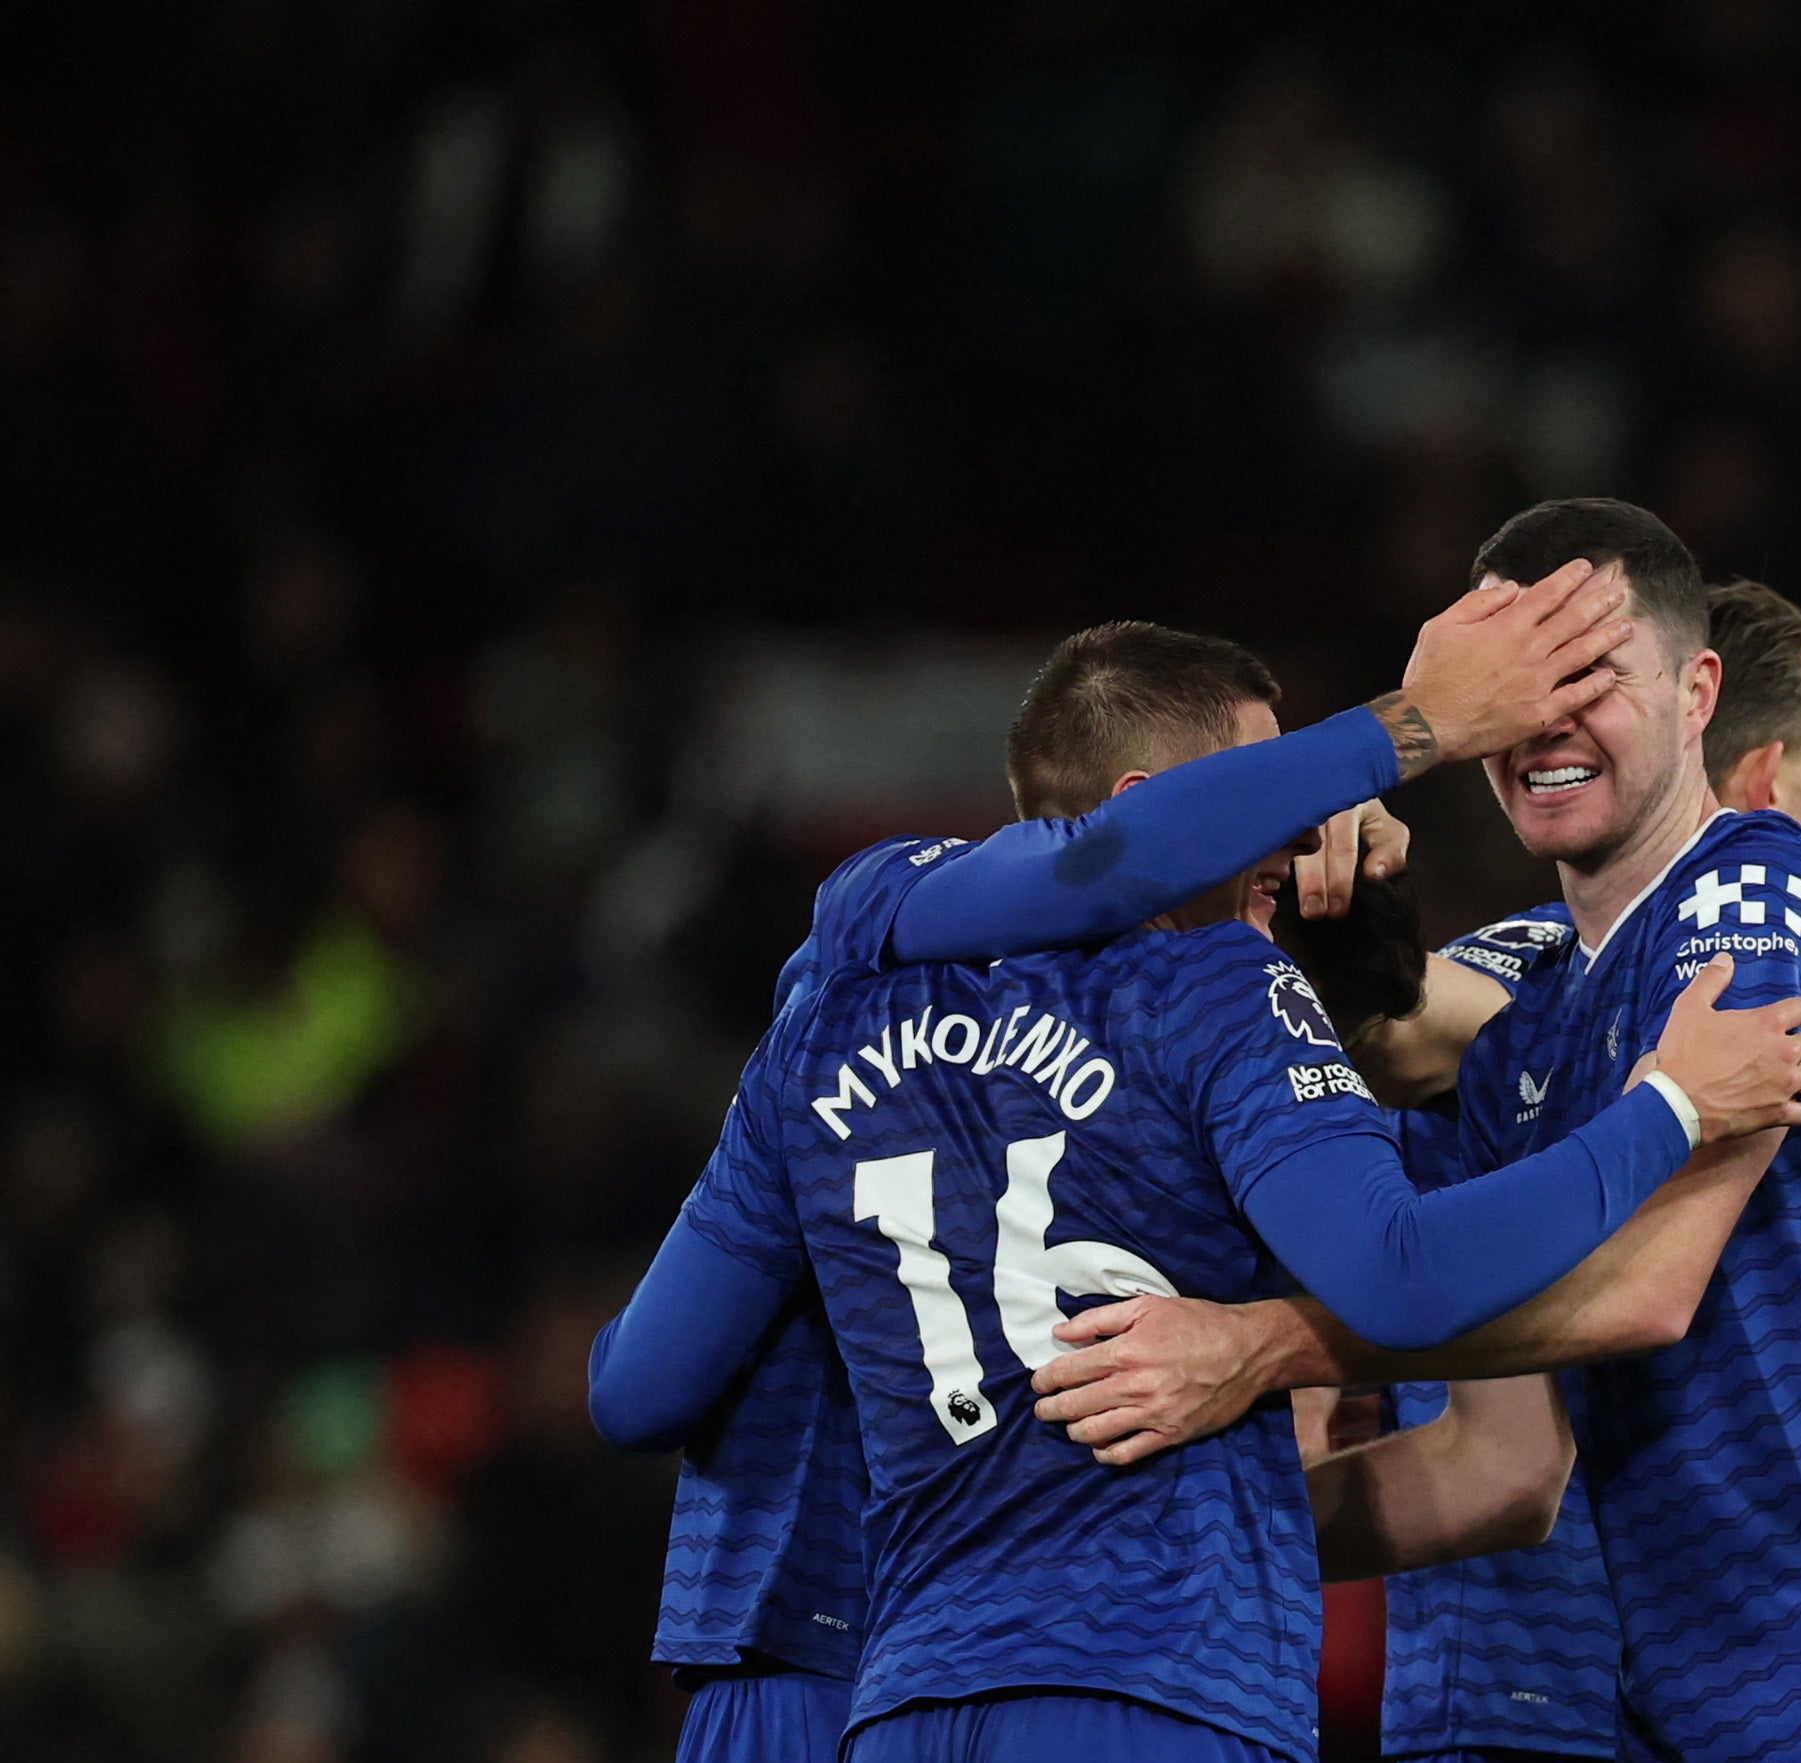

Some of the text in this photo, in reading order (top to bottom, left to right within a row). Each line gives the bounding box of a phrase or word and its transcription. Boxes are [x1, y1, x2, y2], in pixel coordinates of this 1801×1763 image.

[1287, 1065, 1323, 1085] No
[1293, 1081, 1326, 1103] for
[1516, 1104, 1544, 1124] CAST
[853, 1130, 1180, 1446] 16
[812, 1612, 850, 1632] AERTEK
